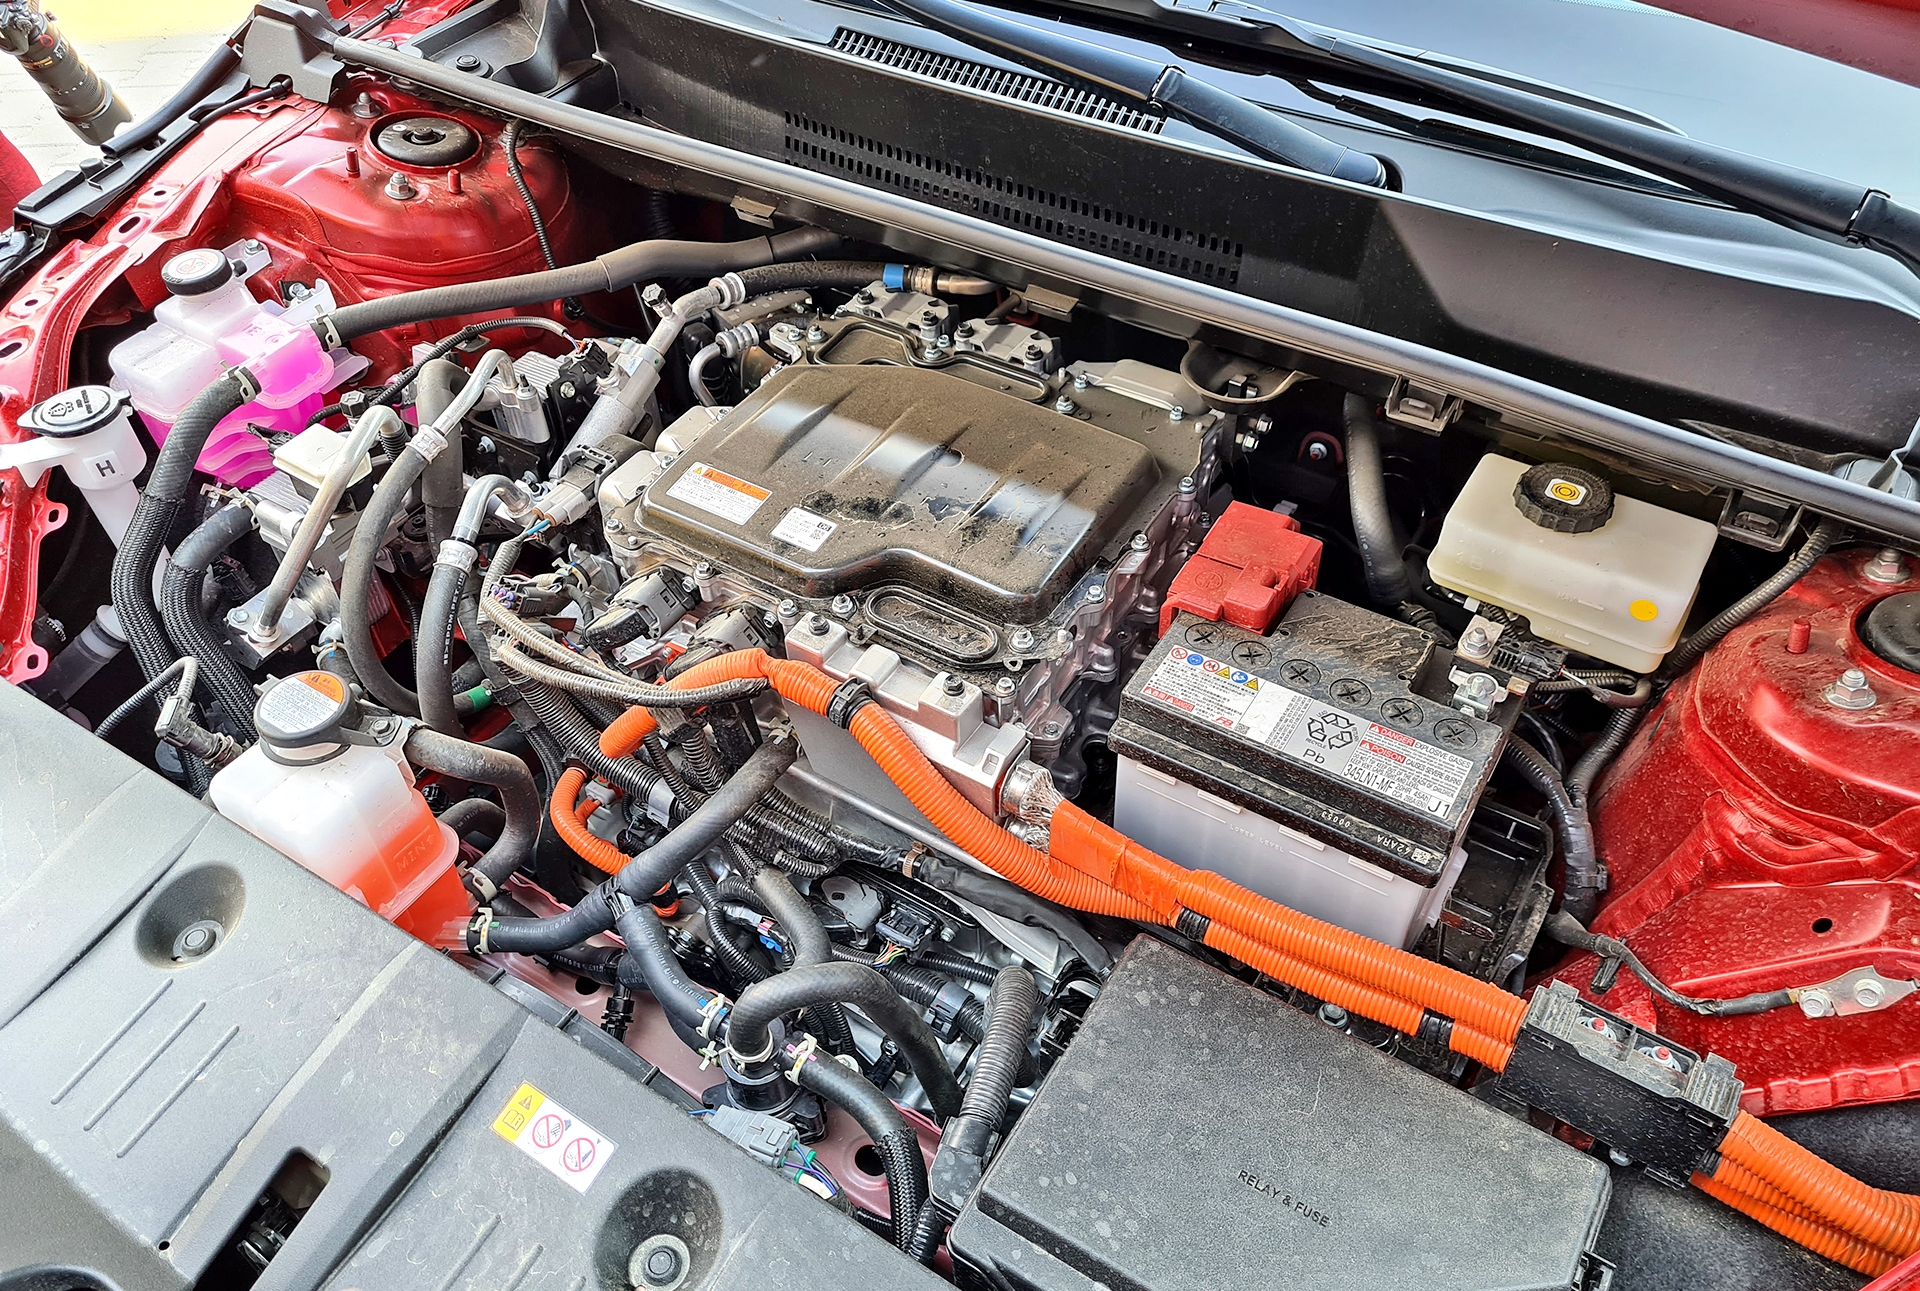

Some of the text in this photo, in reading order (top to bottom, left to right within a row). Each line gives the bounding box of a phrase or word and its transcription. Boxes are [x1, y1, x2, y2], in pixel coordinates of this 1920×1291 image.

[95, 460, 115, 476] H
[1302, 747, 1326, 764] Pb
[1304, 737, 1327, 749] RECYCLE
[1379, 727, 1470, 769] DANGER EXPLOSIVE GASES
[1350, 757, 1361, 765] KEEP
[1360, 762, 1372, 770] VENT
[1371, 766, 1384, 775] CAPS
[1383, 771, 1397, 780] TIGHT
[1396, 776, 1406, 784] AND
[1370, 744, 1462, 786] POISON CAUSES SEVERE BURNS
[1376, 762, 1387, 770] KEEP
[1411, 777, 1425, 786] REACH
[1342, 763, 1394, 794] 345LN1-MF
[1391, 790, 1403, 799] CCA
[1395, 783, 1429, 801] 20HR 45Ah
[1320, 810, 1351, 828] 00053
[1229, 823, 1285, 852] LOWER LEVEL
[395, 841, 426, 871] MIN
[1237, 1169, 1330, 1227] RELAY & FUSE
